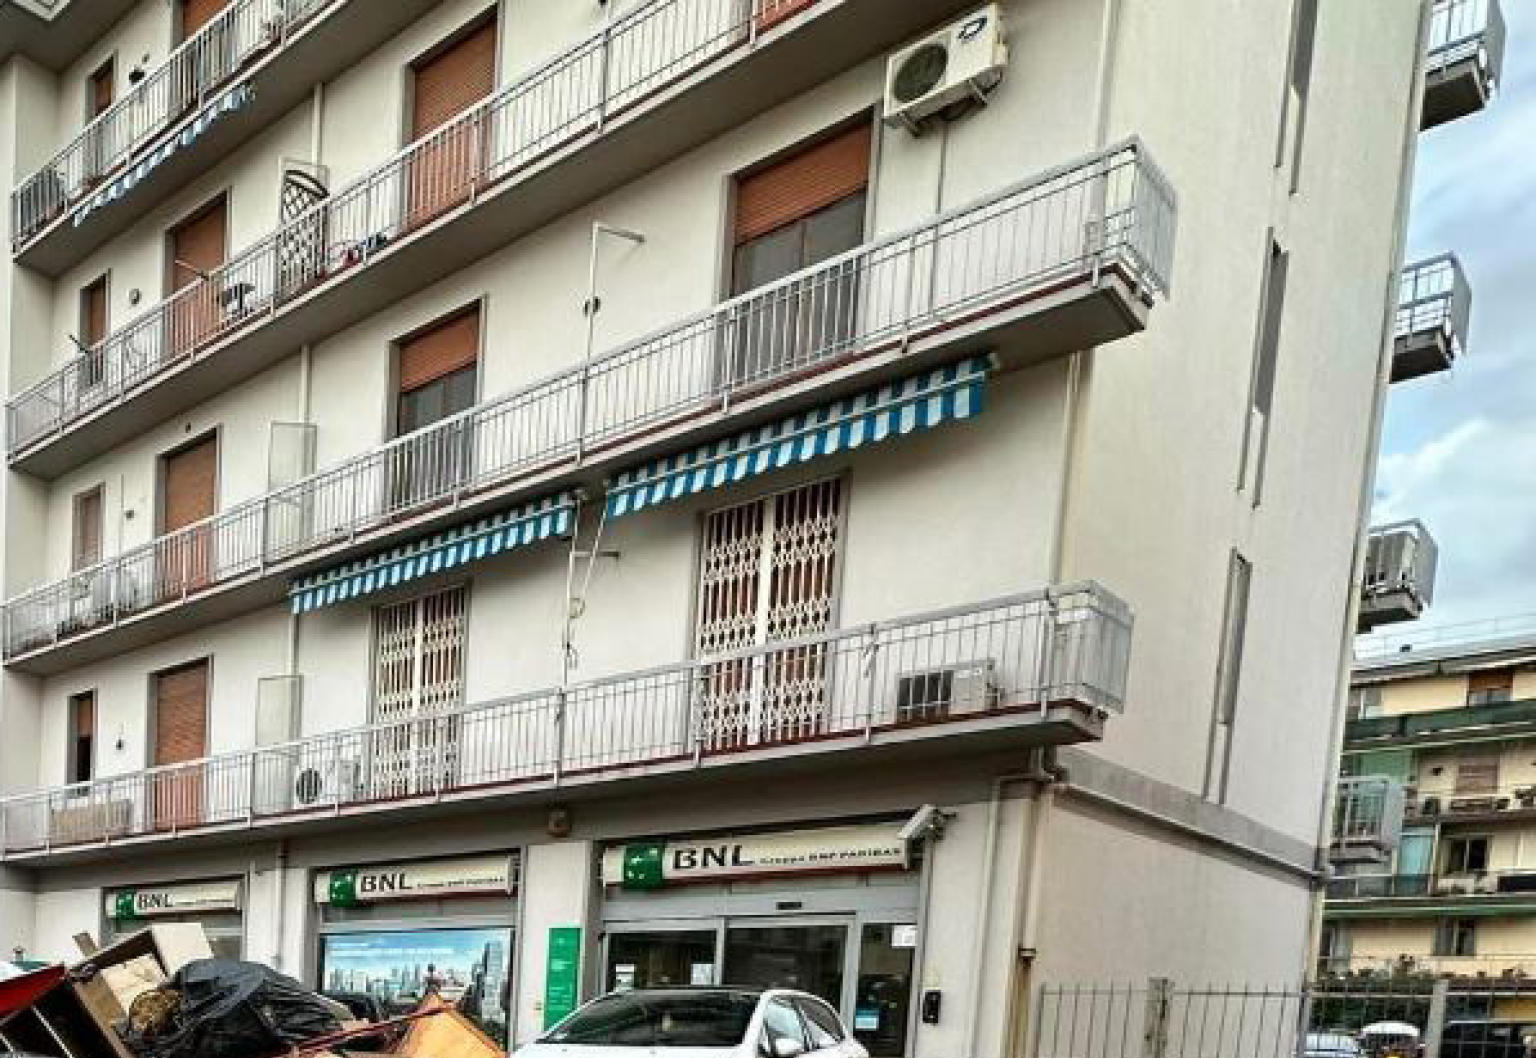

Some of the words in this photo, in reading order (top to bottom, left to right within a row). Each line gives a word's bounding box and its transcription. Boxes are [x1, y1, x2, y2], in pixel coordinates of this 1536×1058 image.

[673, 844, 754, 869] BNL
[360, 873, 413, 893] BNL
[138, 893, 173, 910] BNL
